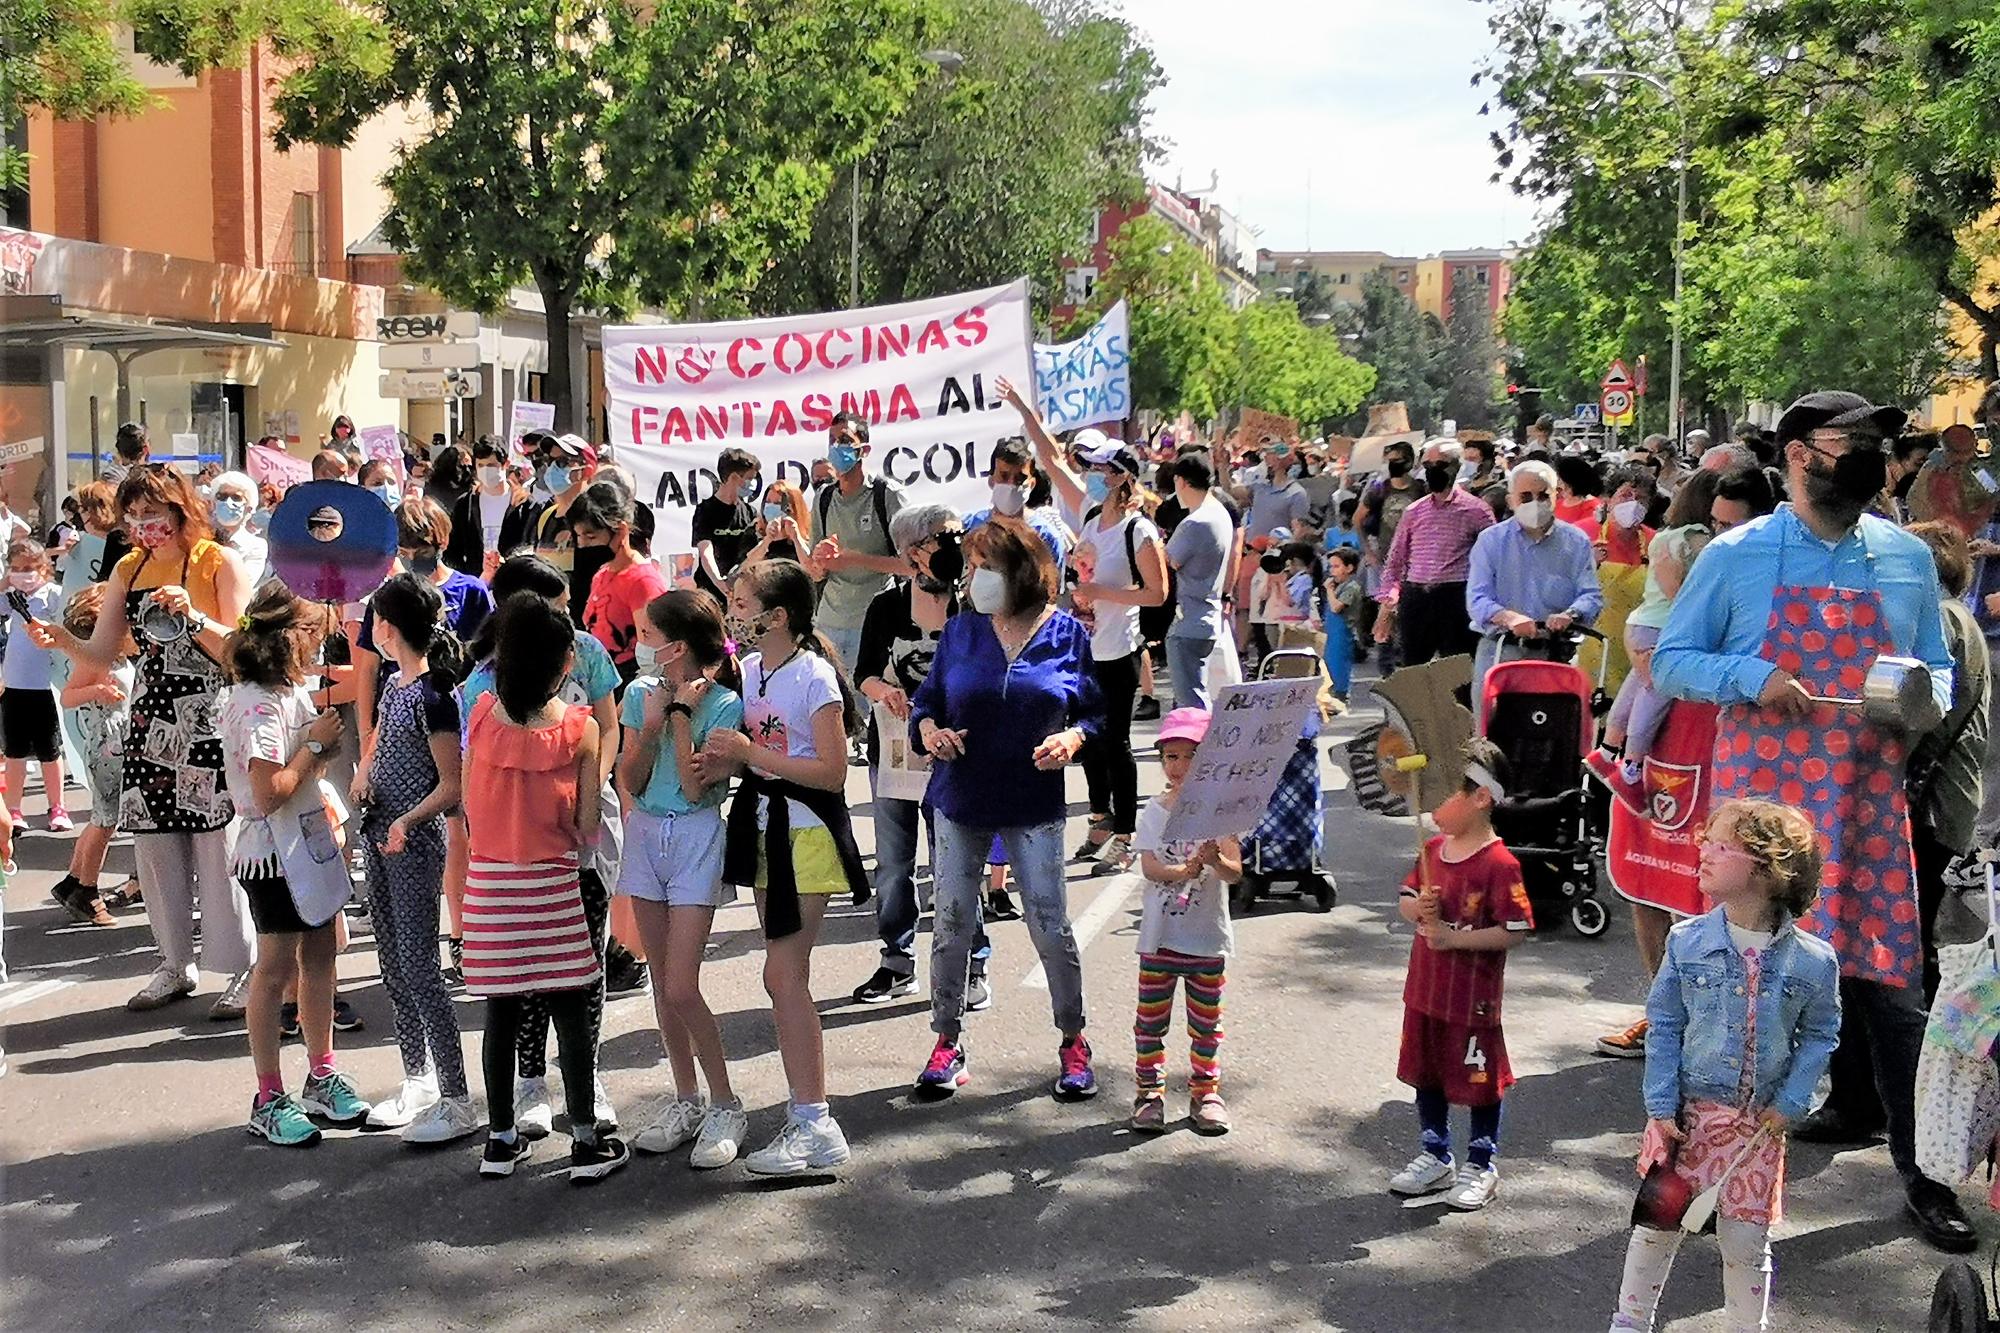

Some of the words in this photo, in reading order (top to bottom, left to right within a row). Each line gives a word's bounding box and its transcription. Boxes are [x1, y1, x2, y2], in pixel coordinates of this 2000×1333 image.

[726, 306, 989, 379] COCINAS
[631, 383, 922, 445] FANTASMA
[1038, 377, 1126, 425] ASMAS
[1607, 396, 1625, 407] 30
[882, 440, 992, 487] COL
[1463, 1035, 1487, 1072] 4
